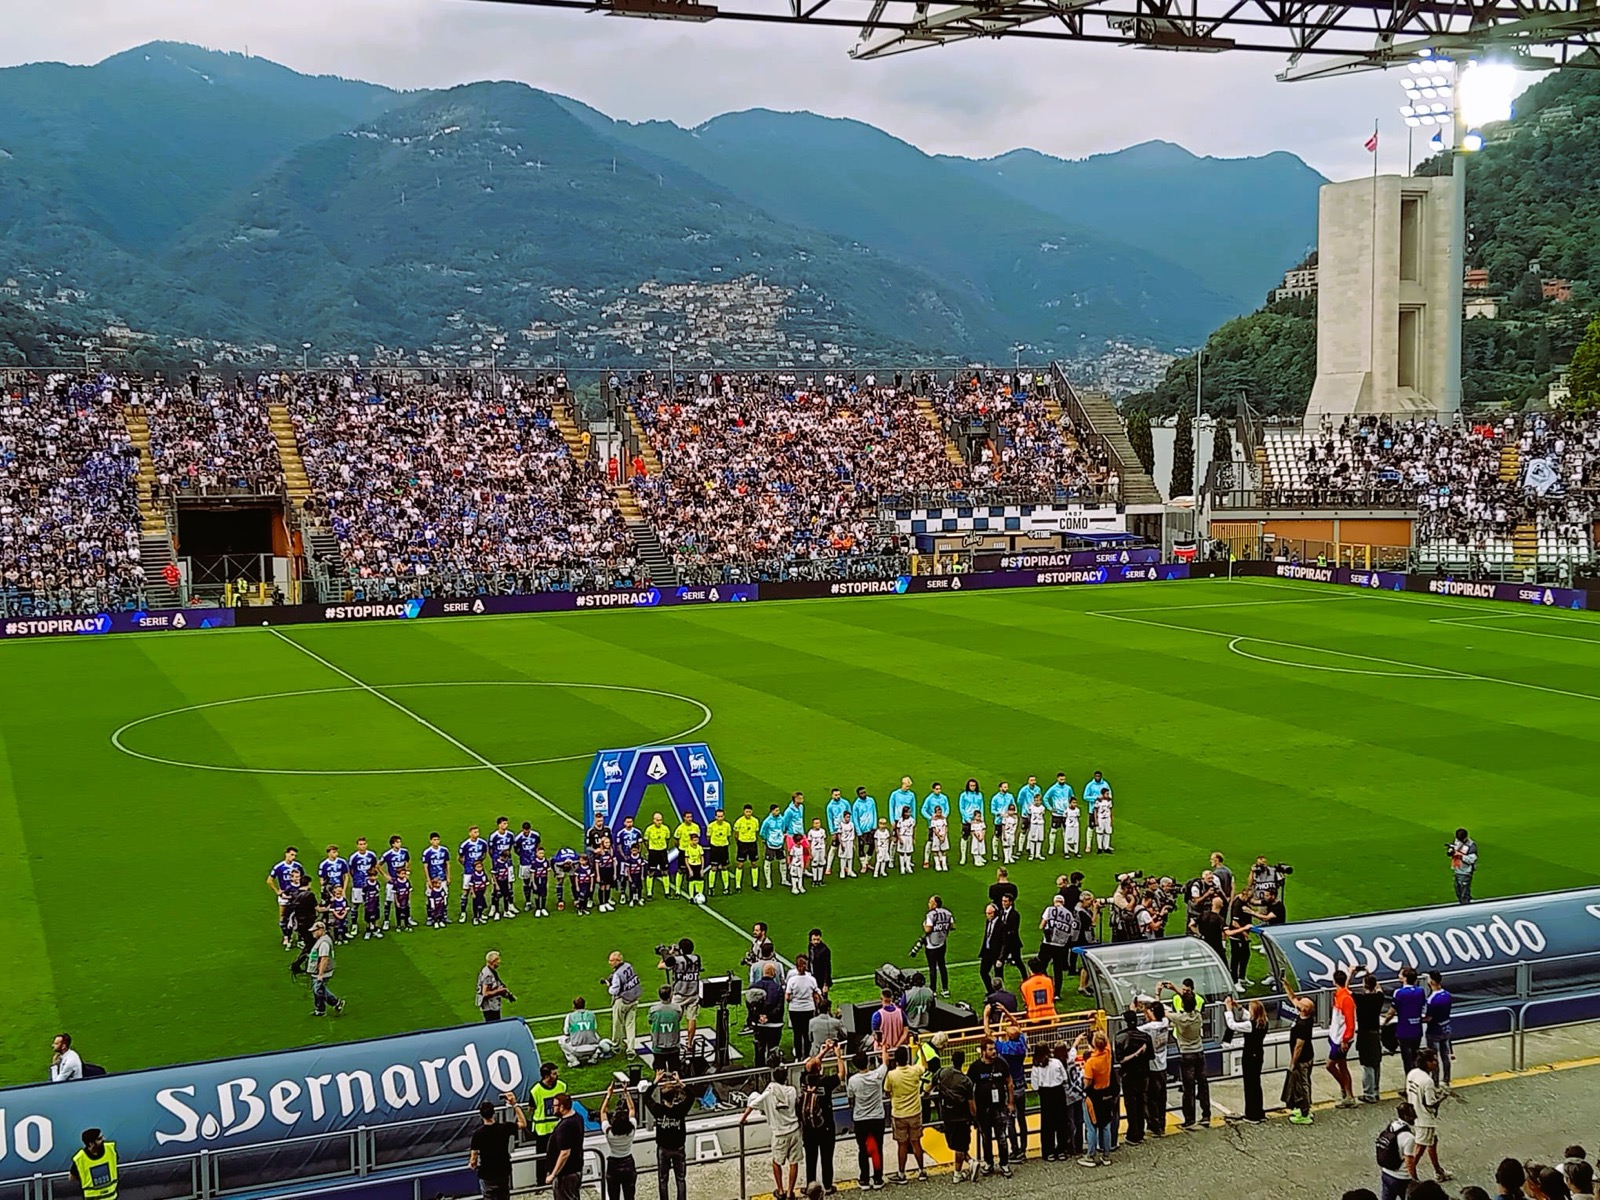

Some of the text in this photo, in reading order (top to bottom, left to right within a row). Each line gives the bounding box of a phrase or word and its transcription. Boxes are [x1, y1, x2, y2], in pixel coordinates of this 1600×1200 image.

[1059, 517, 1088, 530] COMO
[1000, 554, 1072, 568] #STOPIRACY
[1095, 553, 1118, 563] SERIE
[1037, 570, 1103, 584] #STOPIRACY
[1125, 570, 1146, 579] SERIE
[1276, 565, 1333, 582] #STOPIRACY
[1350, 573, 1370, 585] SERIE
[830, 580, 902, 594] #STOPIRACY
[926, 579, 949, 588] SERIE
[1429, 580, 1496, 598] #STOPIRACY
[1519, 589, 1541, 601] SERIE
[575, 591, 655, 607] #STOPIRACY
[682, 590, 706, 600] SERIE
[325, 604, 414, 619] #STOPIRACY
[443, 602, 470, 612] SERIE
[5, 617, 105, 635] #STOPIRACY
[139, 616, 169, 627] SERIE
[577, 1021, 591, 1031] TV
[660, 1022, 674, 1033] TV
